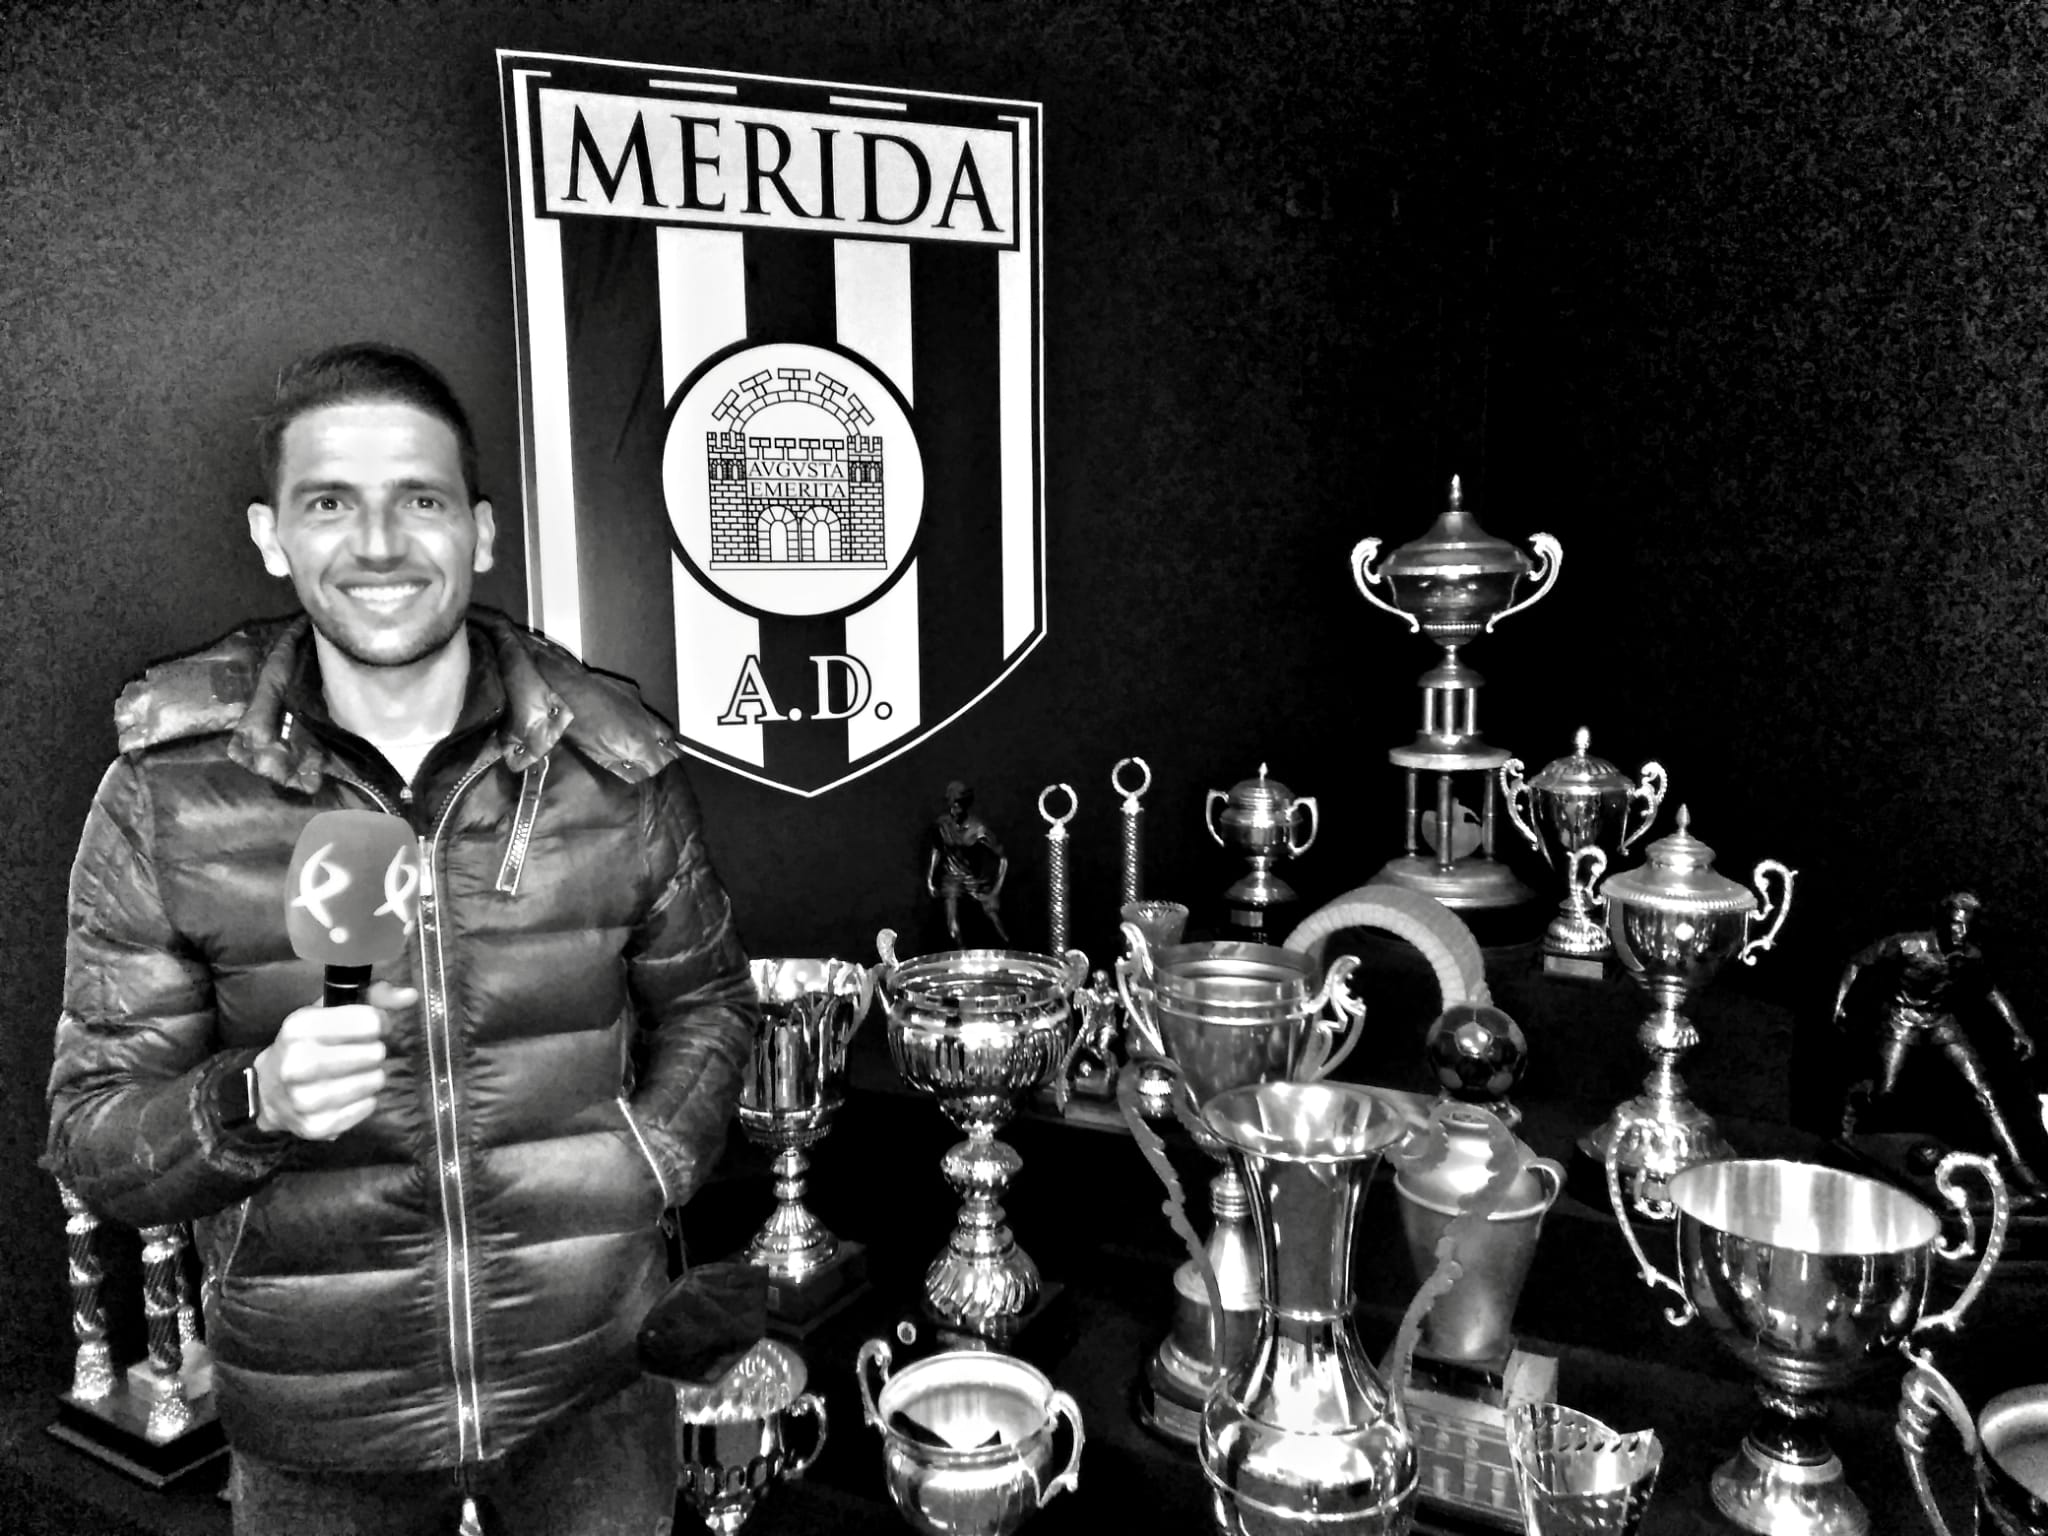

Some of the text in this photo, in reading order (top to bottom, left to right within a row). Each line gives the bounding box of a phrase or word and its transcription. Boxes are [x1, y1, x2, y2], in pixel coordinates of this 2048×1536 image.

[560, 104, 1005, 233] MERIDA
[749, 462, 844, 478] AVGVSTA
[751, 482, 846, 498] EMERITA
[717, 654, 893, 726] A.D.
